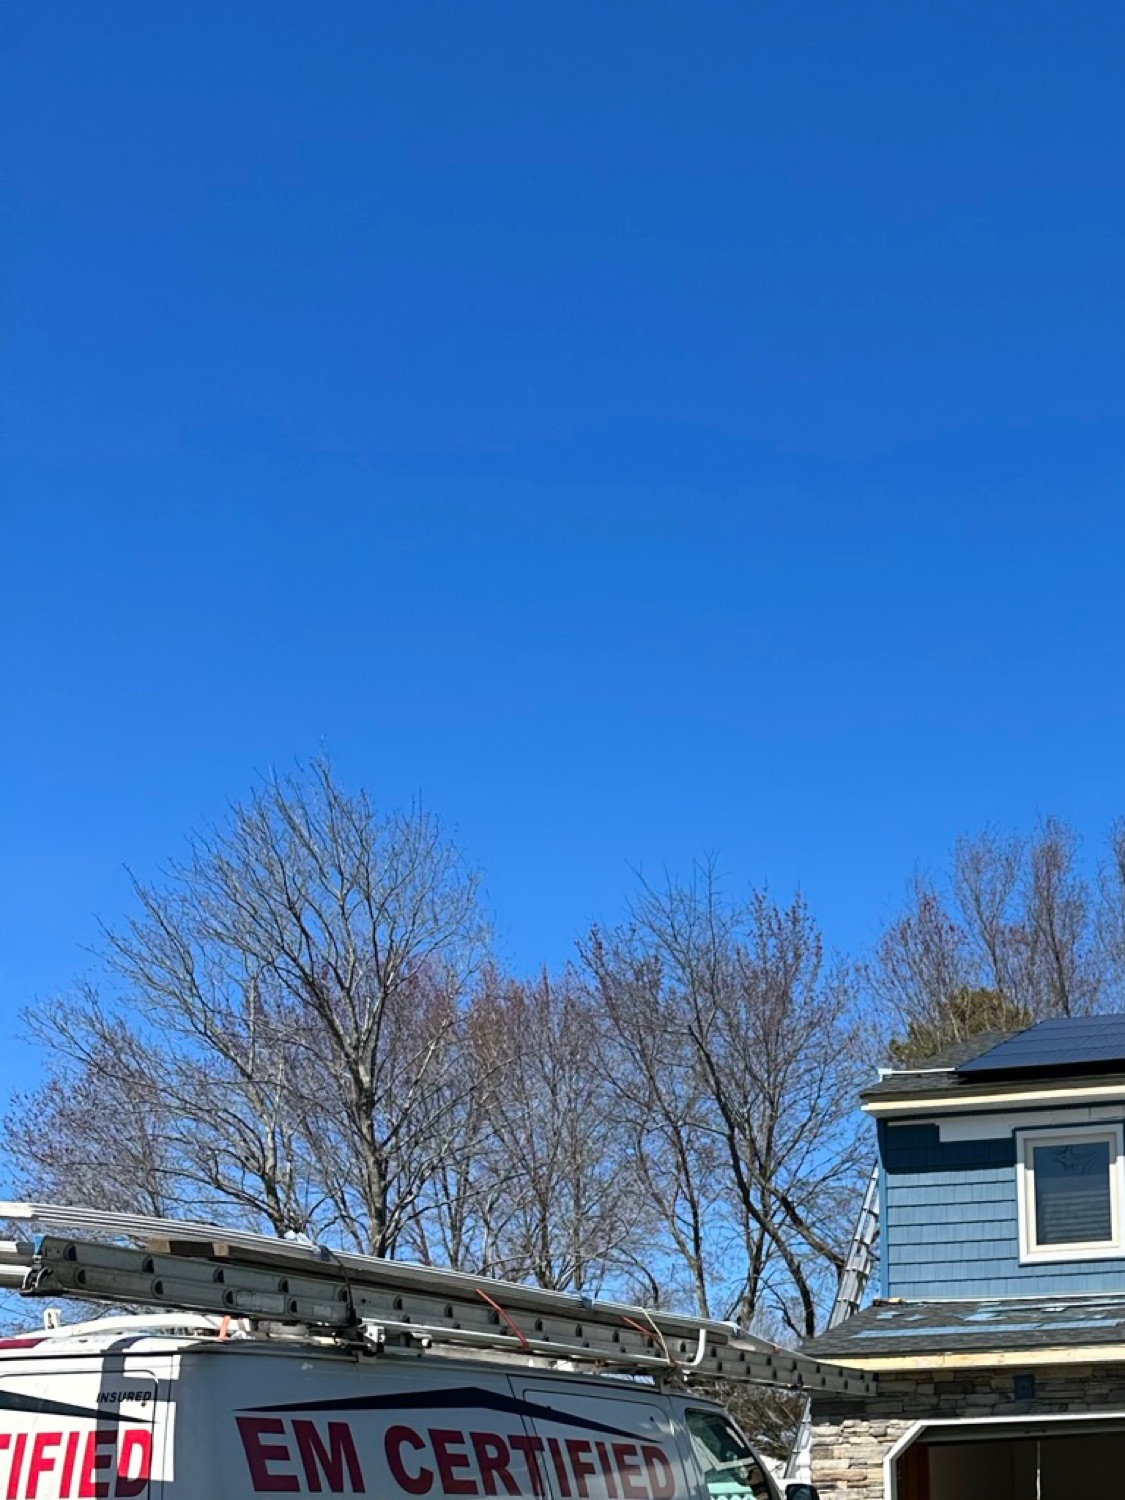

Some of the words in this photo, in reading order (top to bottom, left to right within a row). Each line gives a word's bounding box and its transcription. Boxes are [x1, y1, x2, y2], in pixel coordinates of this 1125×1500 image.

[97, 1391, 152, 1402] INSURED
[235, 1416, 366, 1494] EM
[384, 1425, 677, 1500] CERTIFIED
